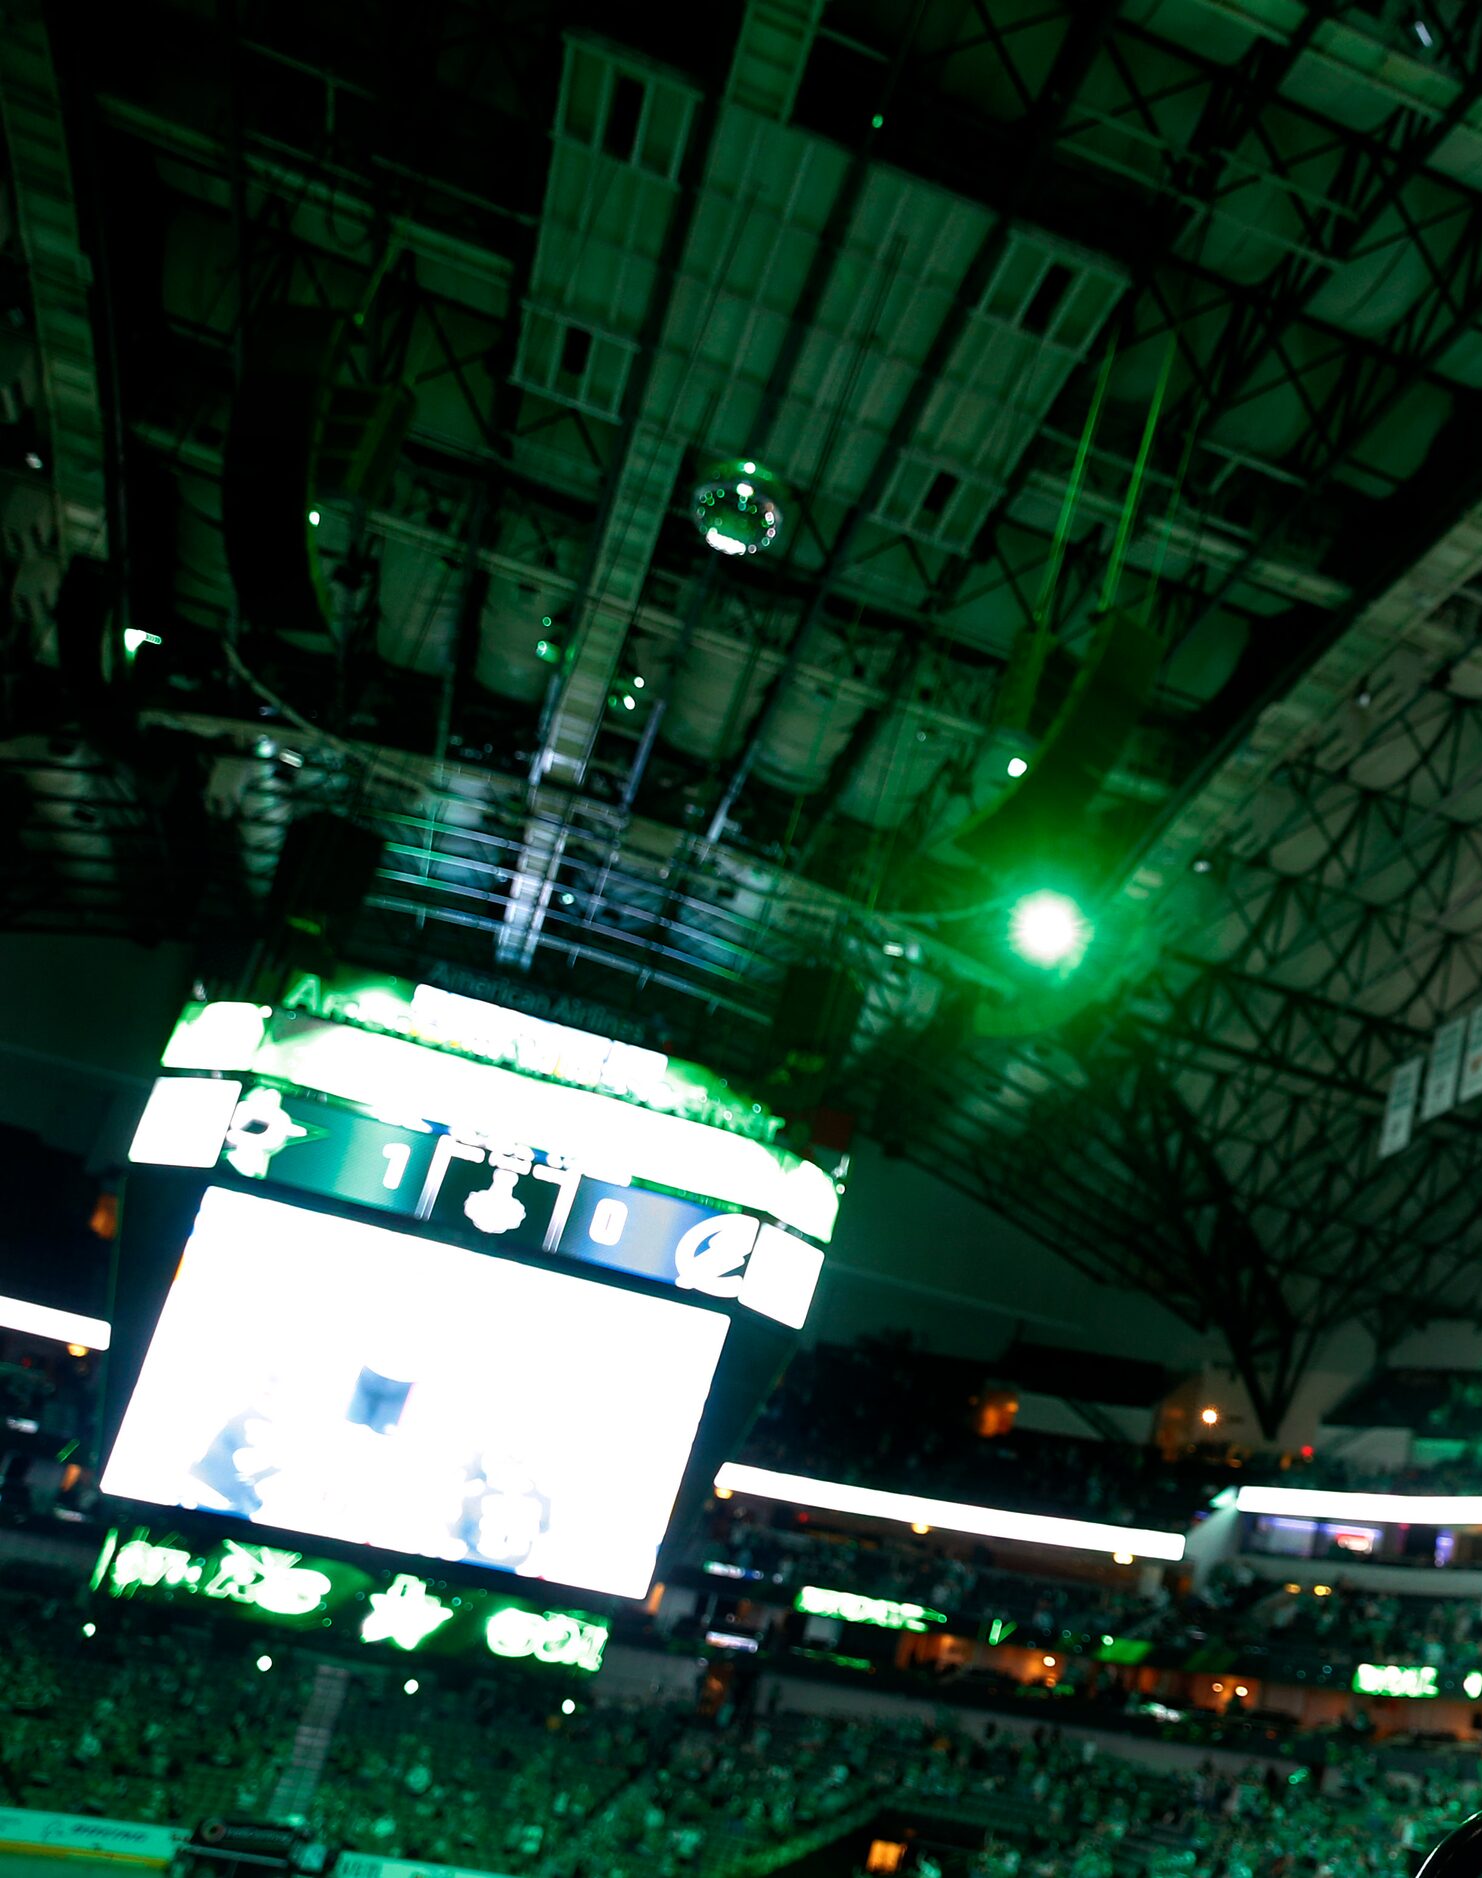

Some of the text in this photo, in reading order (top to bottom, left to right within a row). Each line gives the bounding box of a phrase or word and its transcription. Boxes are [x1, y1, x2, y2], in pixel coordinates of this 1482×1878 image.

[429, 960, 646, 1040] American Airlines
[382, 1143, 411, 1190] 1
[588, 1197, 628, 1246] 0
